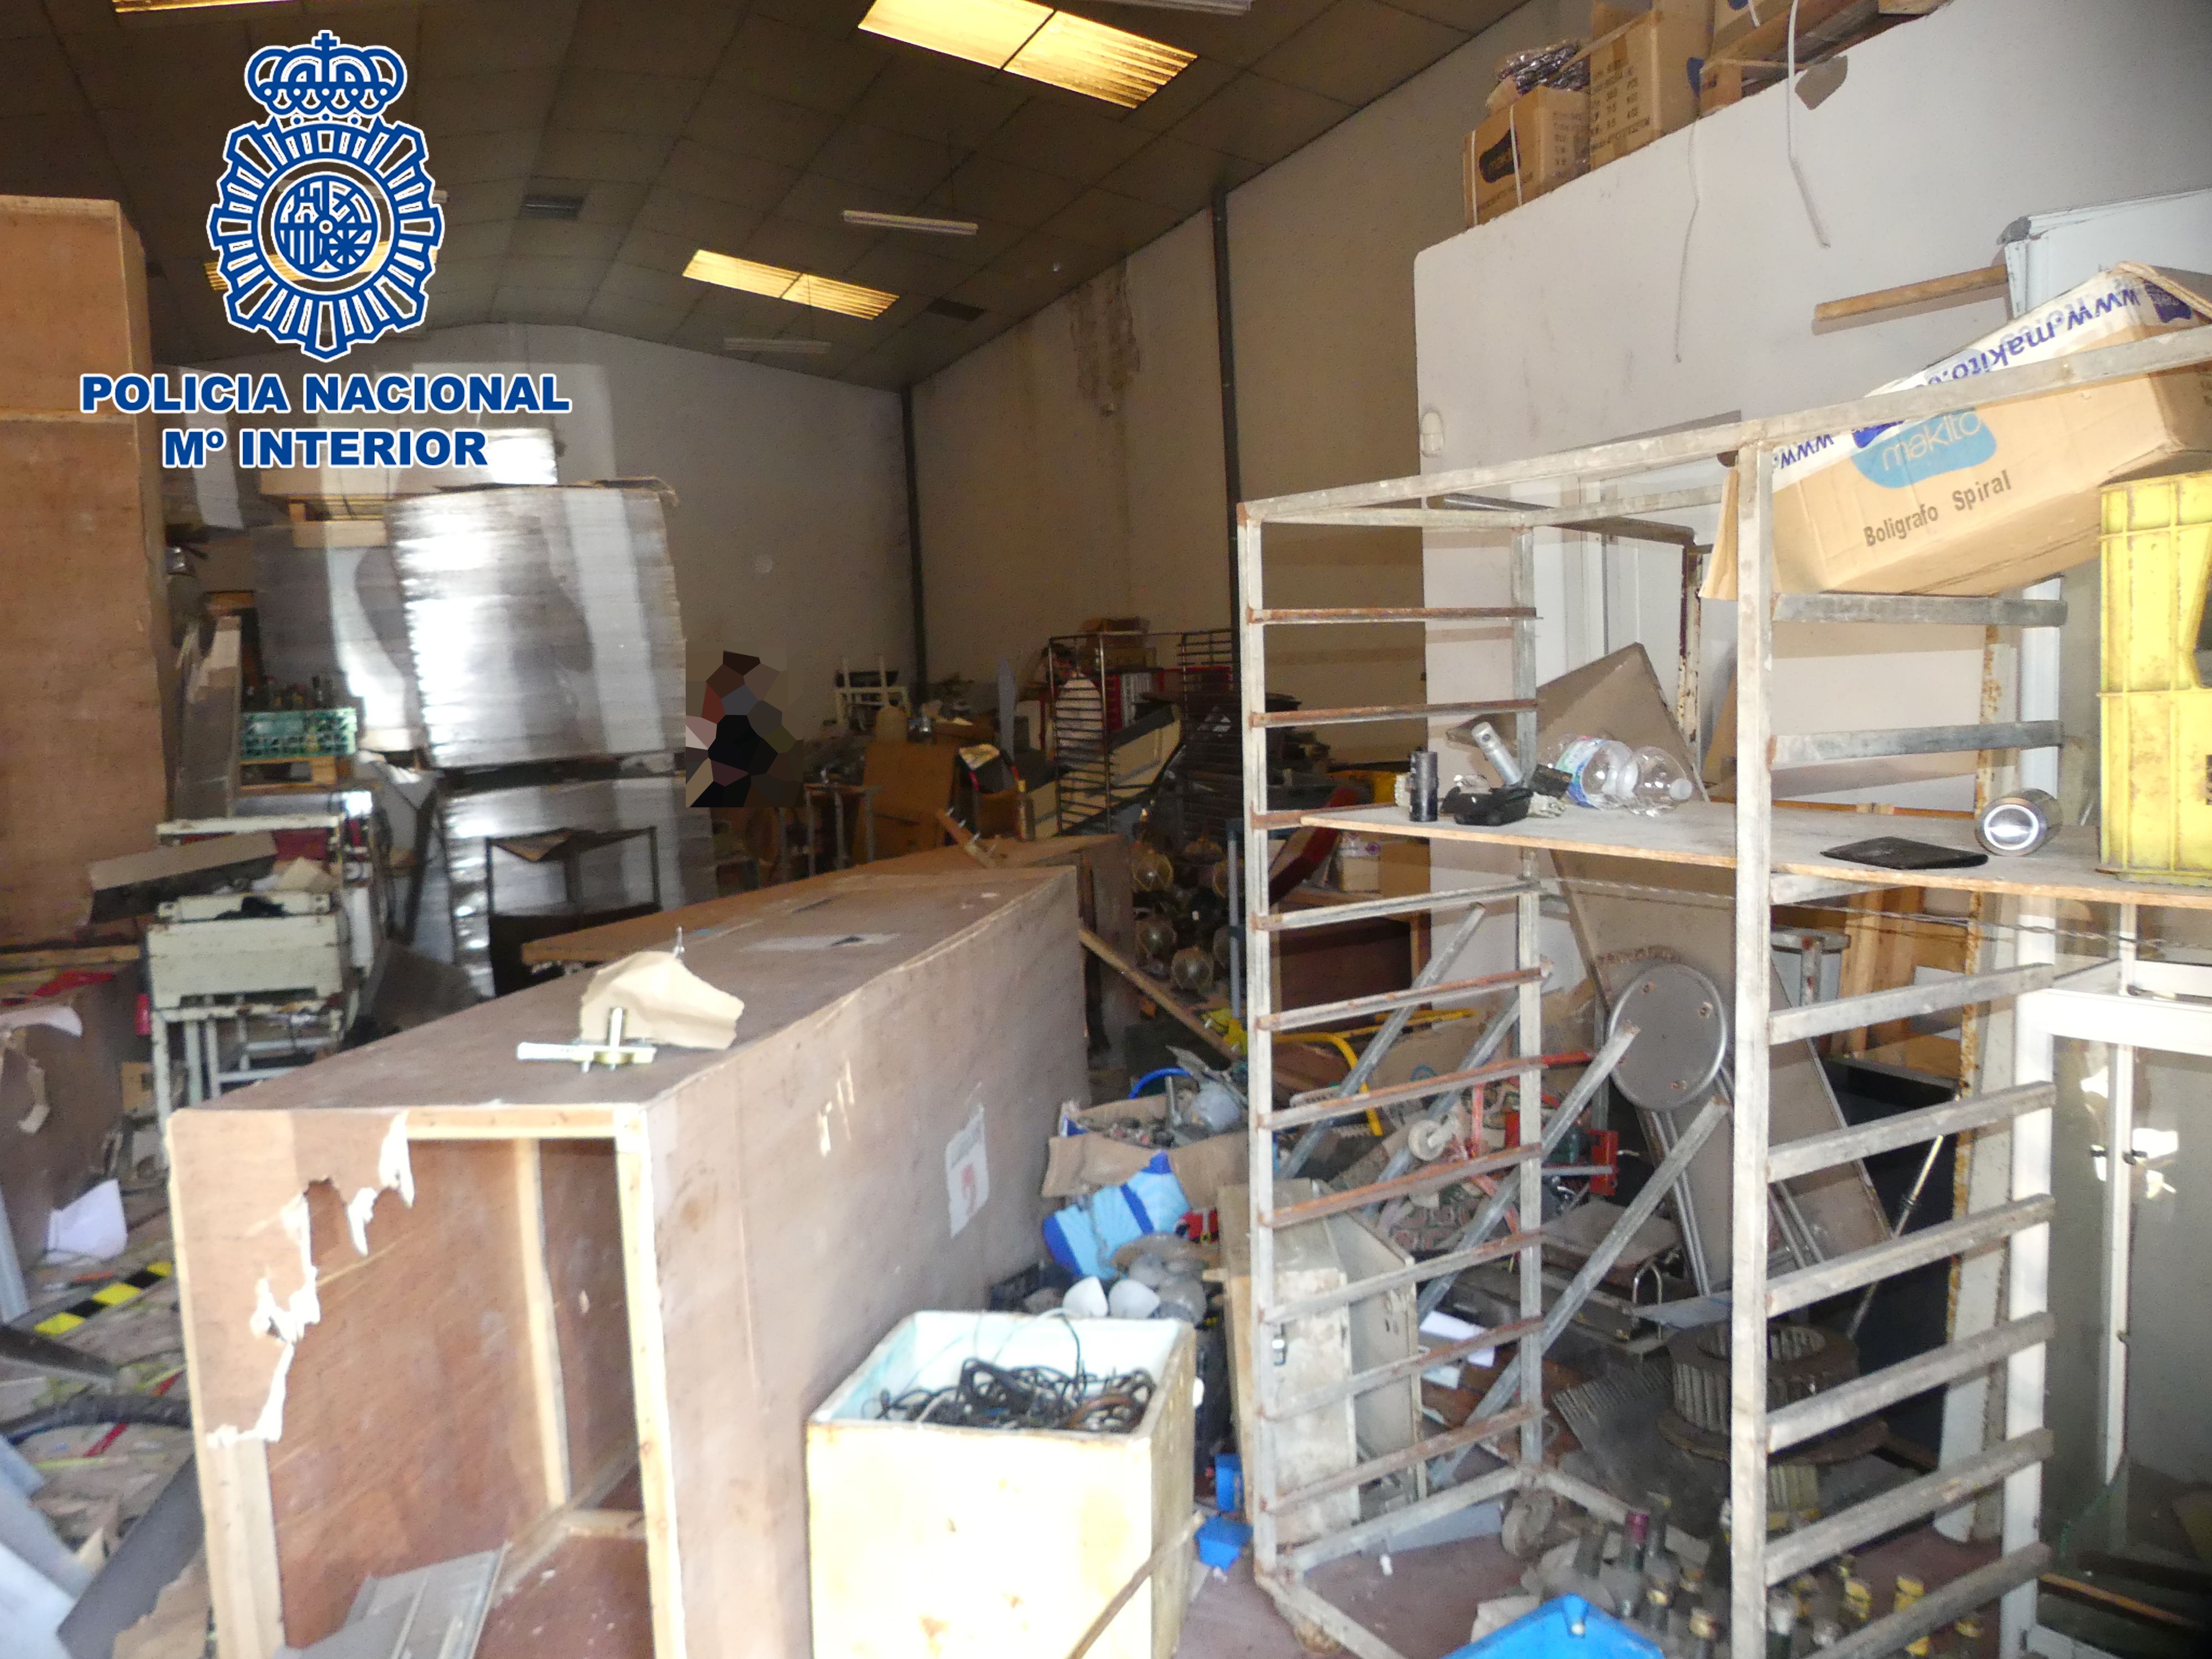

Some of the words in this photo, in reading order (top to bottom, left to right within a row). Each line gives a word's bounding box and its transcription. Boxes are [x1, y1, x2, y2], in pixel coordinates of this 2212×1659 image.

[1914, 288, 2140, 387] www.makito.
[1882, 411, 1981, 471] makito
[1863, 504, 1938, 547] Boligrafo
[1952, 469, 2011, 511] Spiral
